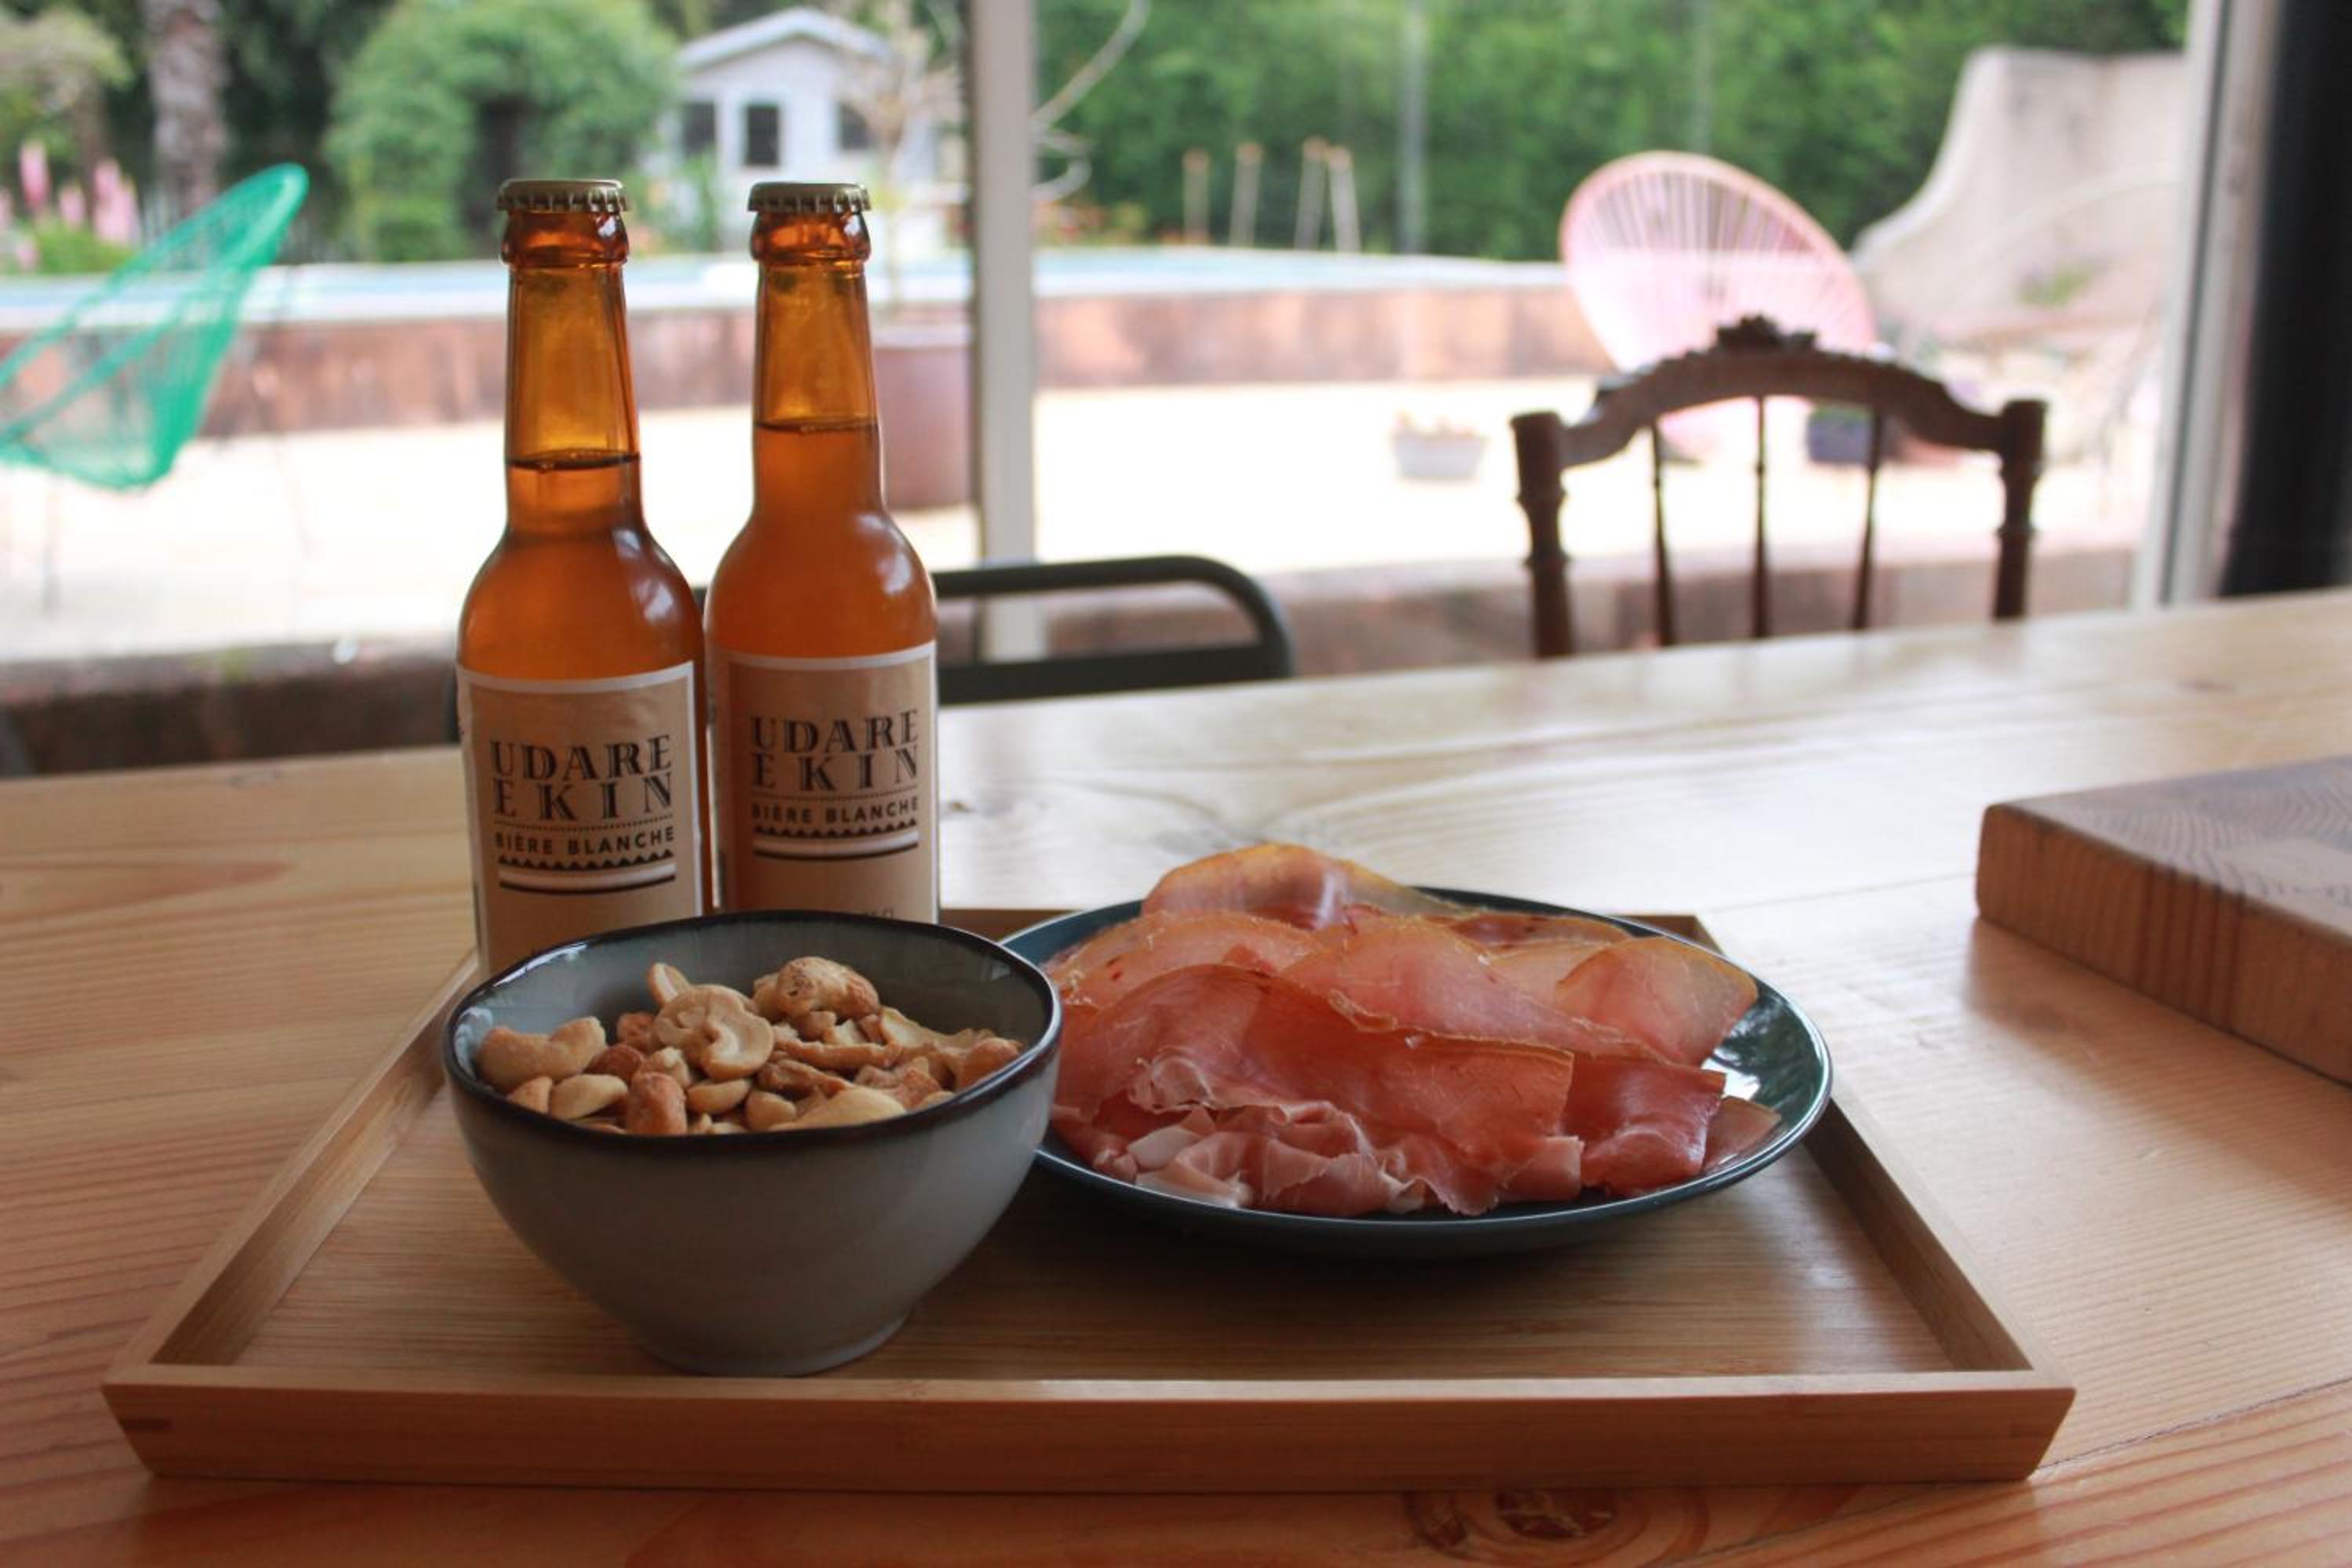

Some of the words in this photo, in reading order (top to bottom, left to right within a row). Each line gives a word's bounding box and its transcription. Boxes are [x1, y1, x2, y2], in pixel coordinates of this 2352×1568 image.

[750, 710, 918, 753] UDARE
[490, 735, 672, 781] UDARE
[750, 746, 917, 791] EKIN
[493, 772, 673, 821] EKIN
[826, 797, 918, 824] BLANCHE
[568, 826, 675, 855] BLANCHE
